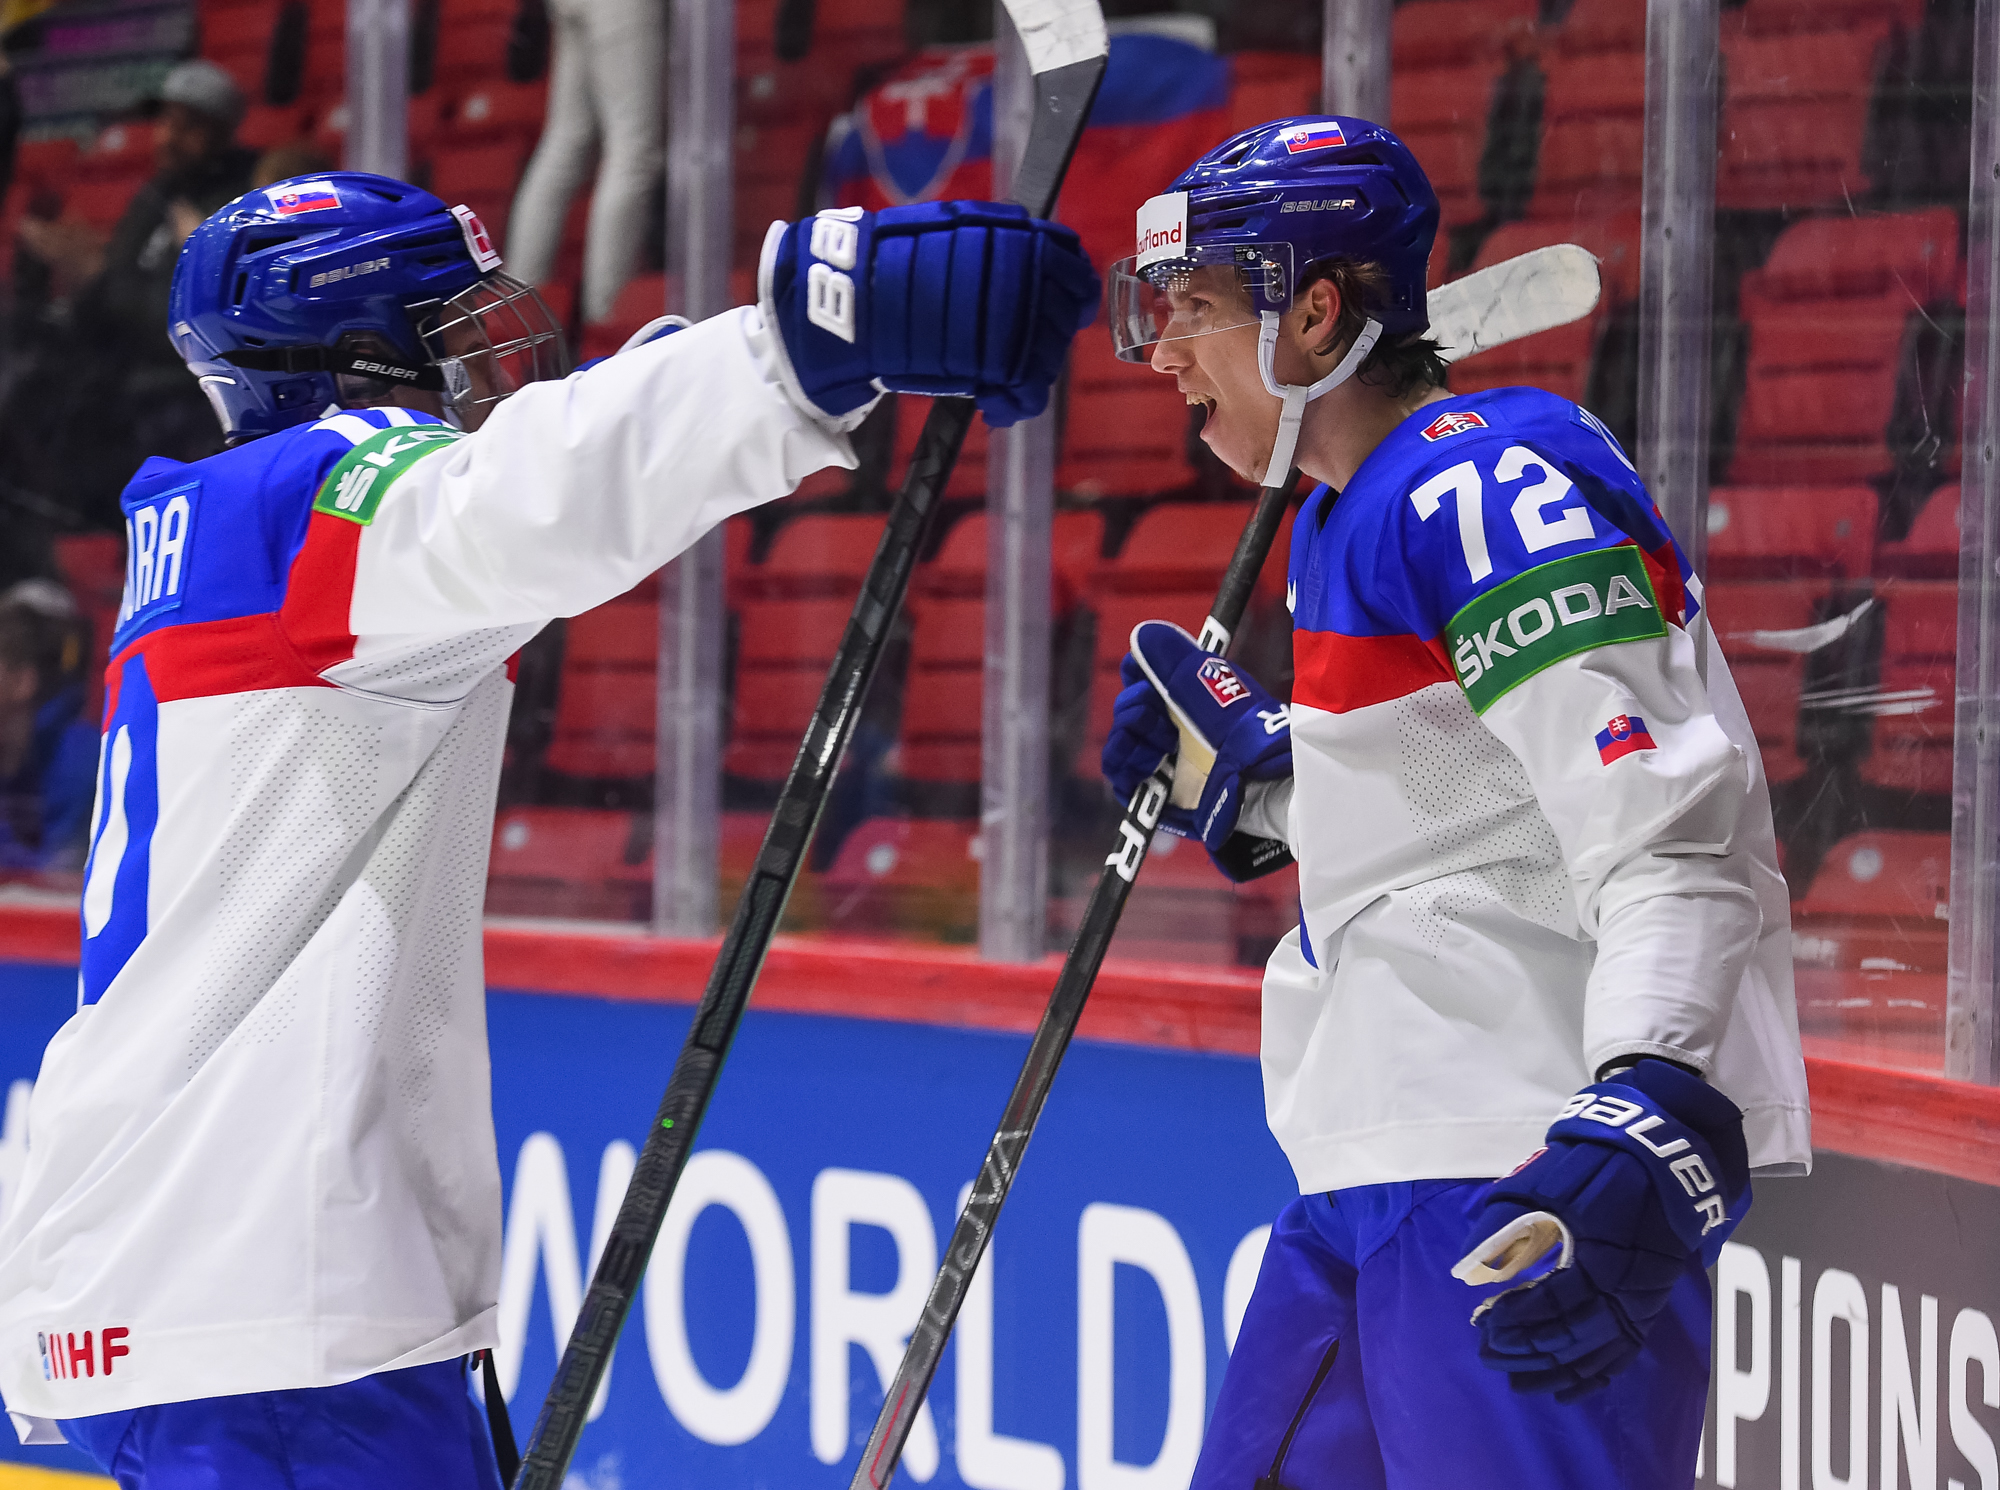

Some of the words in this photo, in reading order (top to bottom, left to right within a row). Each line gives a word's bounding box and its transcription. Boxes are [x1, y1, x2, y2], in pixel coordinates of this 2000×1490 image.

[1280, 199, 1357, 213] BAUER
[309, 257, 391, 288] BAUER
[351, 359, 419, 380] BAUER
[1409, 445, 1596, 585] 72
[1454, 574, 1654, 689] ŠKODA
[1553, 1092, 1726, 1236] BAUER
[48, 1326, 130, 1380] IIHF
